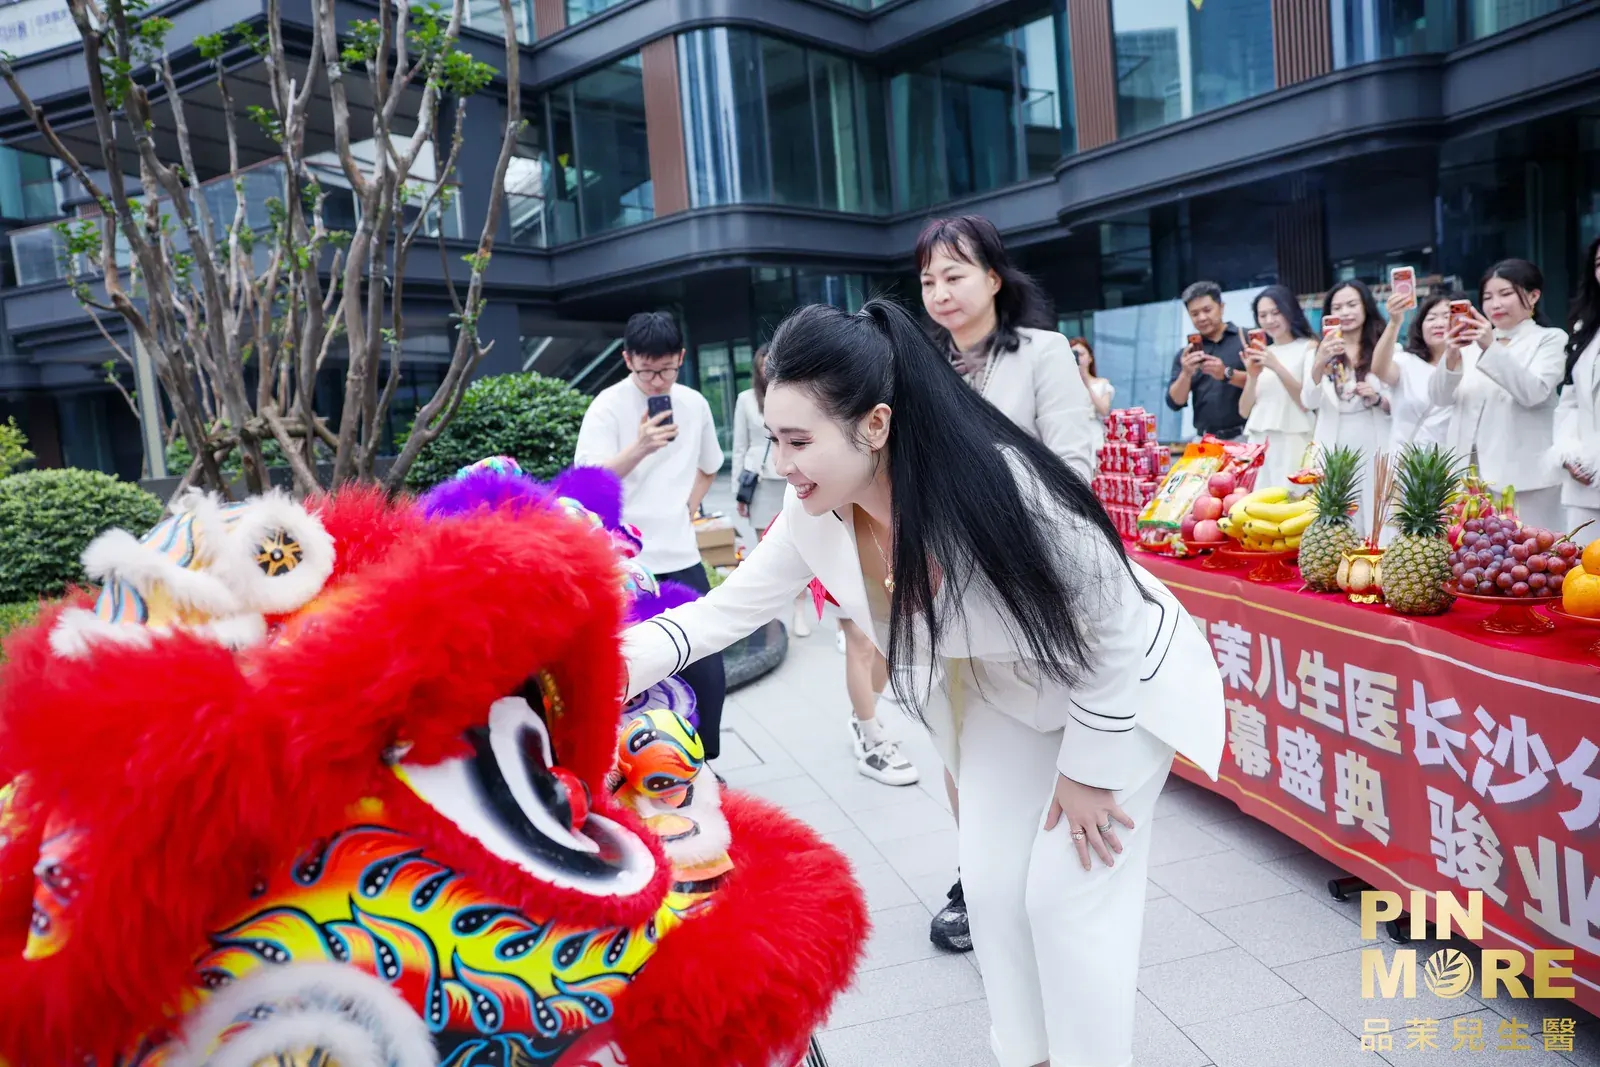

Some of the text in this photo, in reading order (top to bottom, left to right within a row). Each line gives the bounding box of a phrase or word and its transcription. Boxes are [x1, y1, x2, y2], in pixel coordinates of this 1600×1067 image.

[1191, 615, 1600, 831] 茉儿生医长沙分
[1226, 698, 1391, 847] 幕盛典
